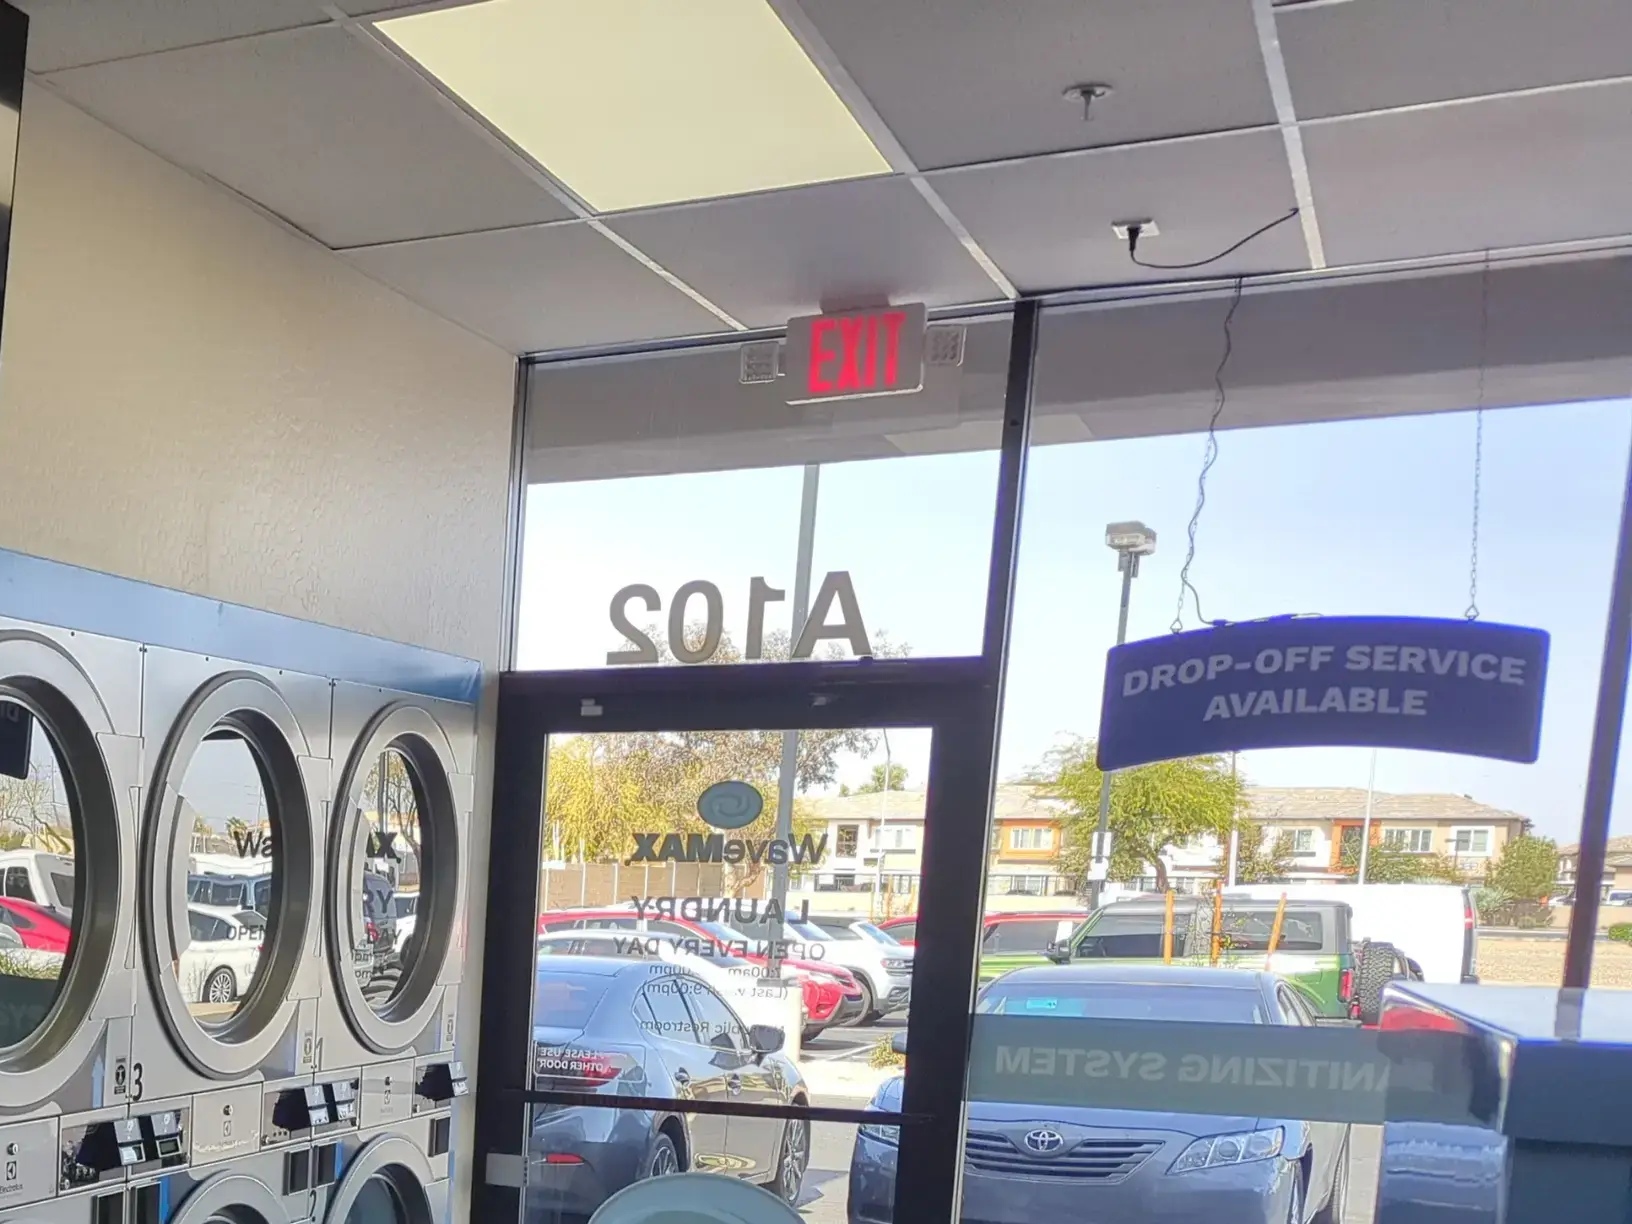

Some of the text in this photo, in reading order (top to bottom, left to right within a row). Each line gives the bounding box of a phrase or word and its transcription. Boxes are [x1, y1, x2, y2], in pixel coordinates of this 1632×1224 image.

[808, 312, 906, 394] EXIT
[1122, 645, 1526, 697] DROP-OFF SERVICE
[1203, 687, 1428, 722] AVAILABLE
[133, 1063, 143, 1101] 3
